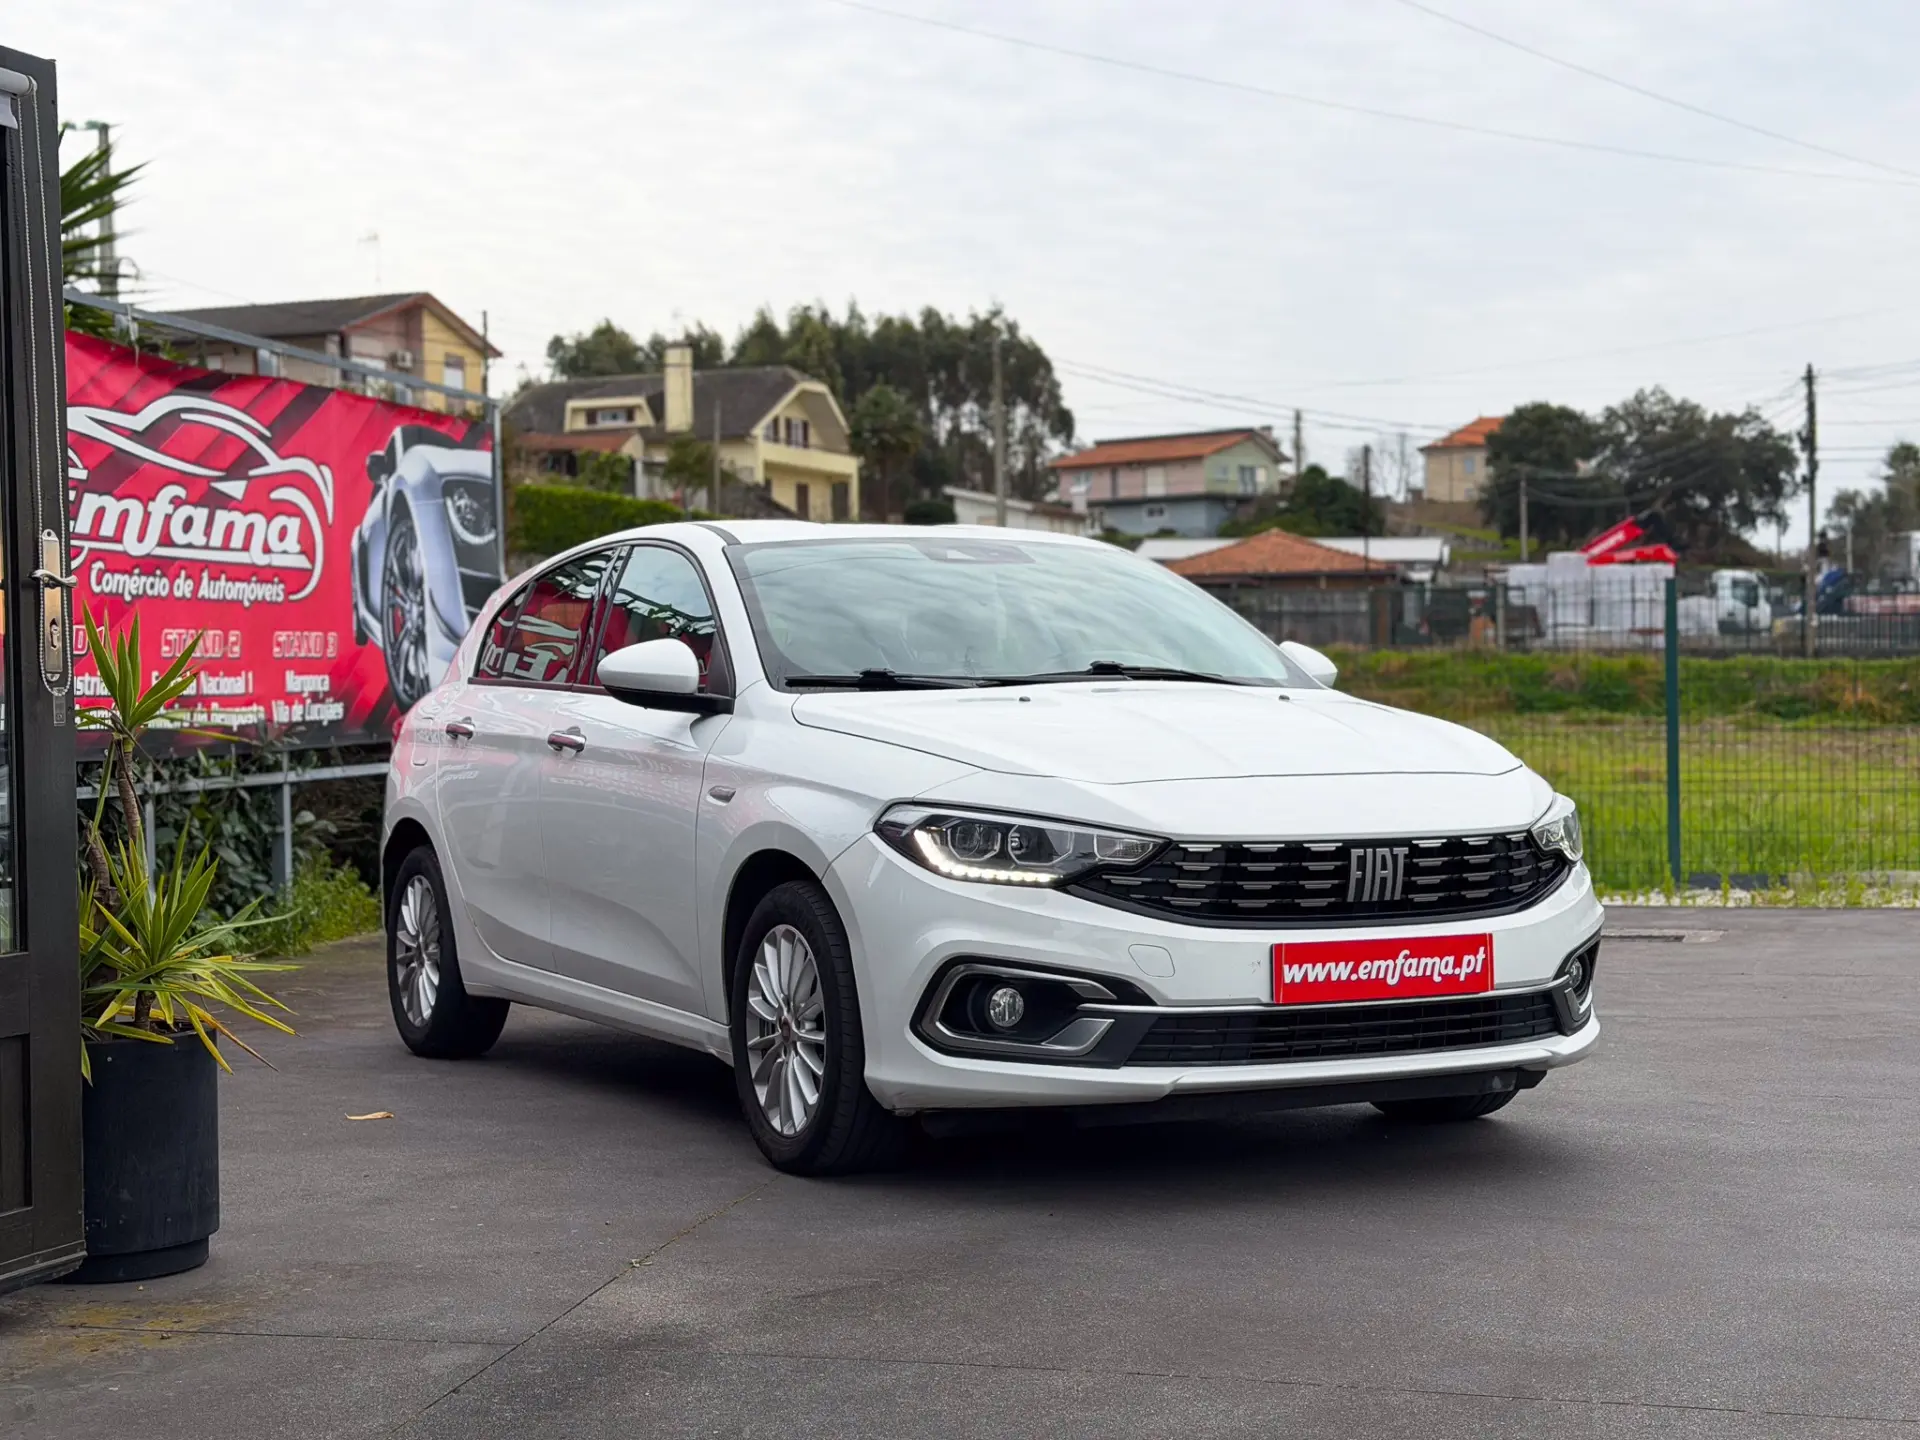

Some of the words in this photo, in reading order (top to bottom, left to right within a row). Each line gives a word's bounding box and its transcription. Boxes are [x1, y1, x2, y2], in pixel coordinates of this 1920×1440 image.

[69, 484, 302, 567] mfama
[90, 560, 170, 602] Comércio
[173, 569, 194, 599] de
[197, 570, 285, 608] Automóveis
[161, 628, 224, 658] STAND
[227, 630, 242, 659] 2
[272, 631, 325, 659] STAND
[326, 631, 338, 659] 3
[200, 670, 246, 695] Nacional
[1347, 847, 1409, 902] FIAT
[1283, 947, 1486, 986] www.emfama.pt
